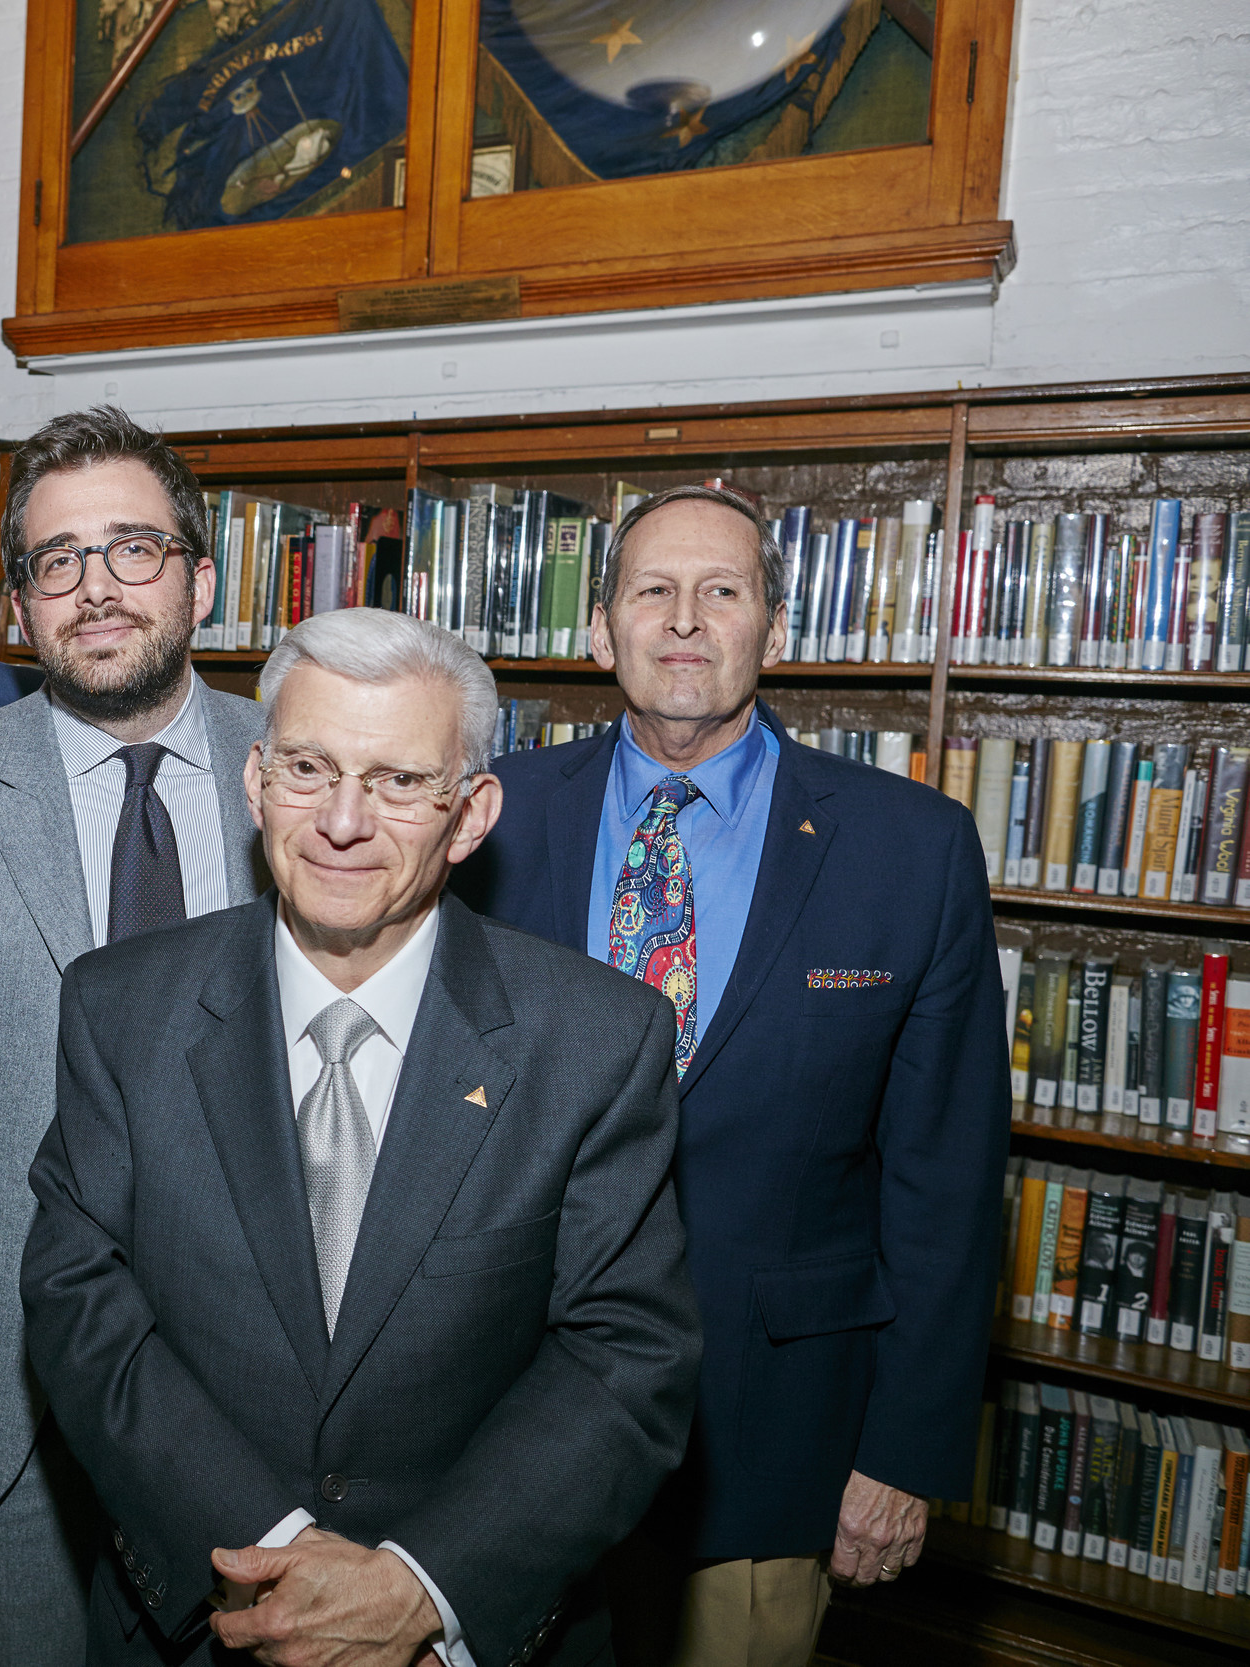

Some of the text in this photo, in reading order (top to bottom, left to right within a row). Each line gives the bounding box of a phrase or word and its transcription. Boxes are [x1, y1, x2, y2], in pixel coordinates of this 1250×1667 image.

[293, 553, 301, 609] COLOR
[1235, 540, 1247, 586] Berryman's
[1229, 588, 1243, 637] Shakespeare
[1152, 797, 1180, 874] Muriel Spar
[1216, 788, 1241, 872] Virginia Wool
[1090, 1213, 1120, 1223] Edward
[1126, 1219, 1156, 1231] Edward
[1214, 1249, 1228, 1277] back
[1097, 1283, 1109, 1302] 1
[1131, 1292, 1149, 1310] 2
[1210, 1281, 1223, 1308] then
[1054, 1416, 1070, 1491] JOHN UPDIKE
[1072, 1425, 1087, 1491] ALICE WALKER
[1090, 1436, 1105, 1483] WALKER
[1036, 1447, 1054, 1511] Considerations
